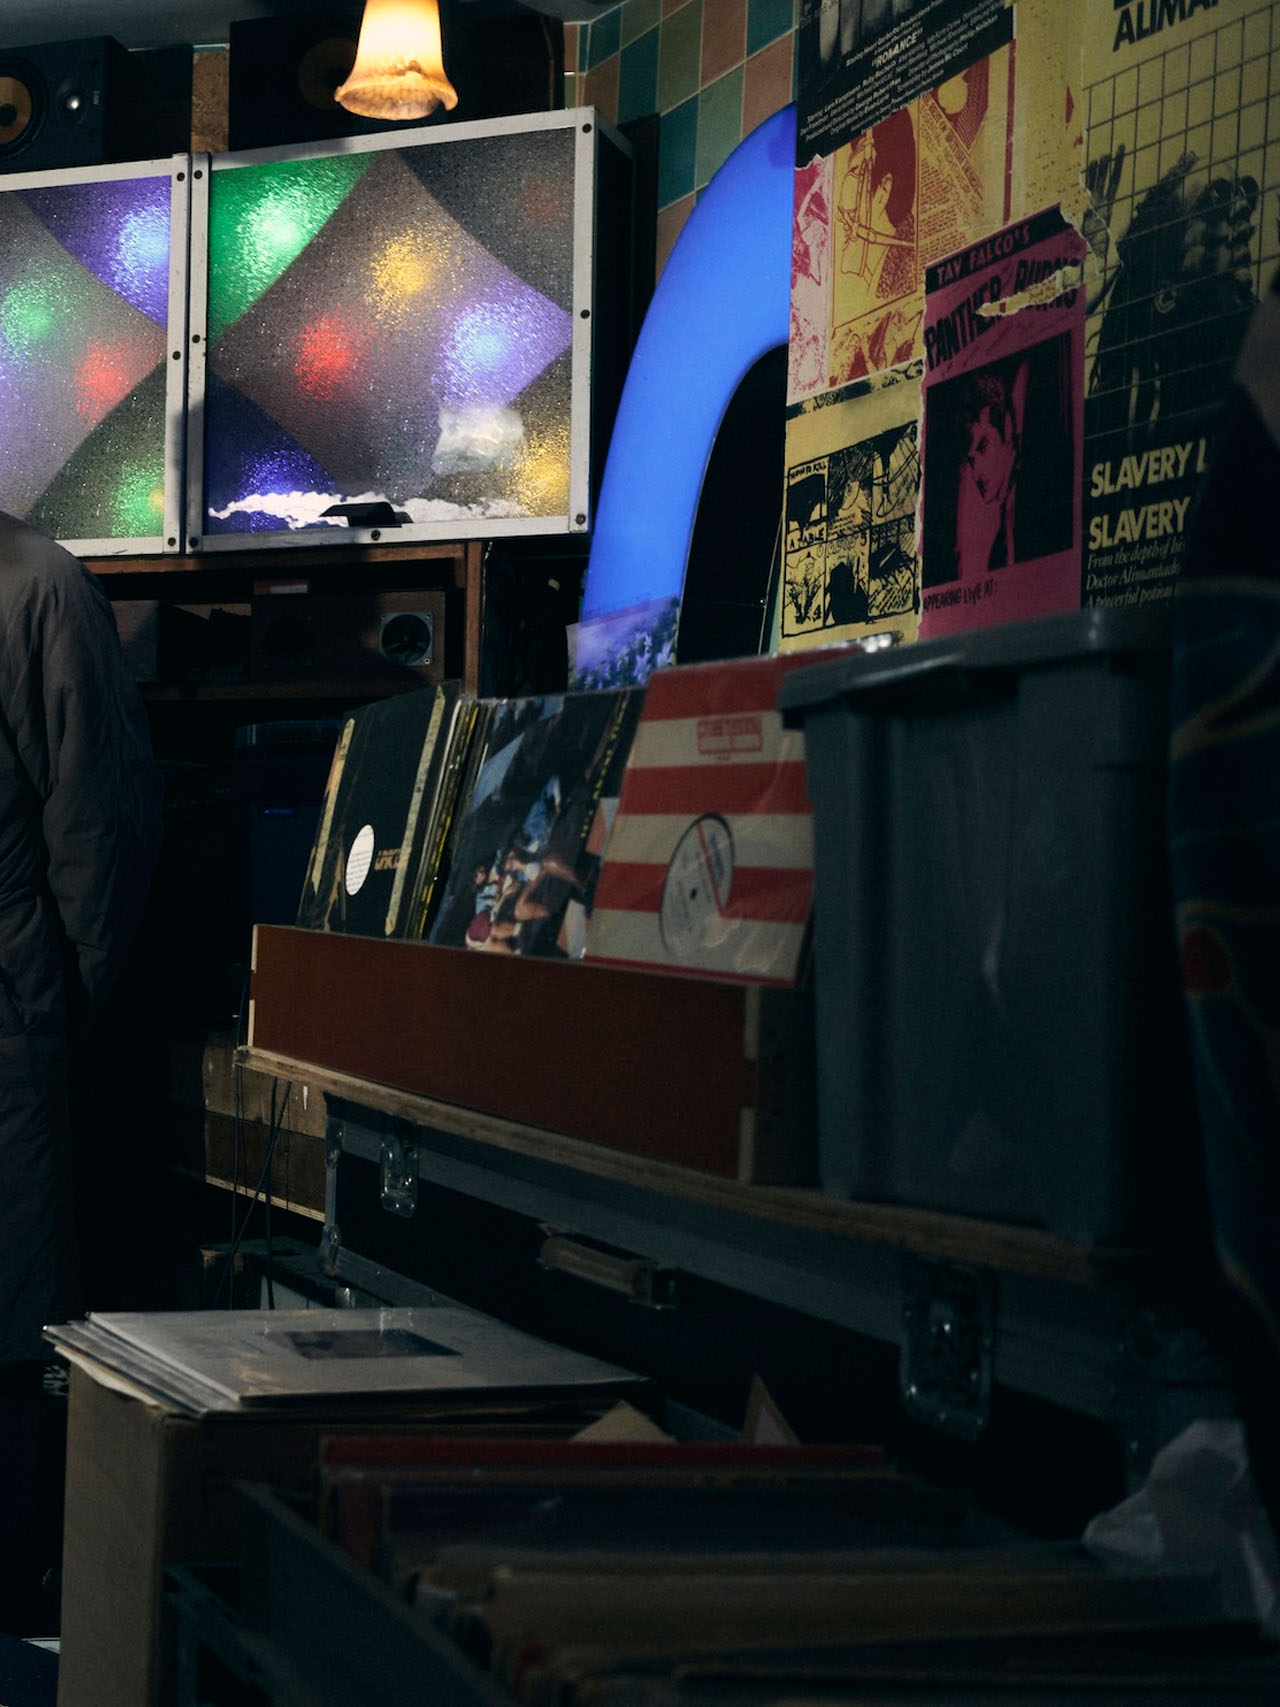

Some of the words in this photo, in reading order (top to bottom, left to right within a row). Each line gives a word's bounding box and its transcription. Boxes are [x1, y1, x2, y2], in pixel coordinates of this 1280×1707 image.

[1113, 0, 1218, 52] ALIM
[970, 224, 1031, 272] FALCO'S
[1090, 441, 1194, 498] SLAVERY
[1088, 496, 1192, 550] SLAVERY
[1086, 574, 1119, 591] Doctor
